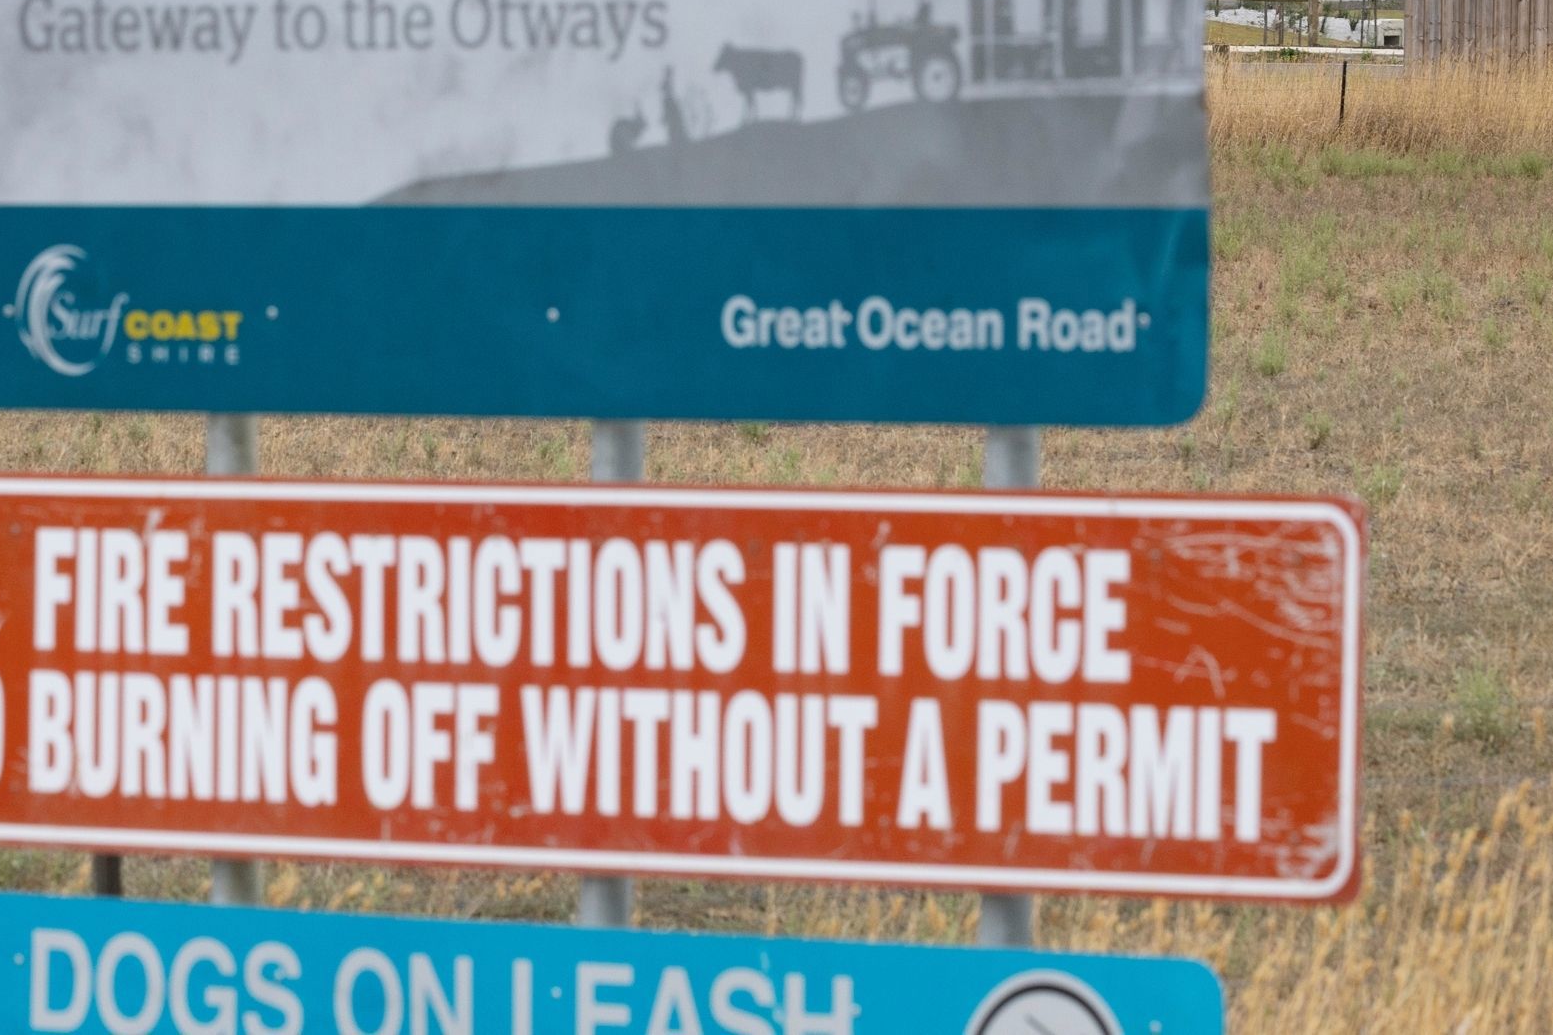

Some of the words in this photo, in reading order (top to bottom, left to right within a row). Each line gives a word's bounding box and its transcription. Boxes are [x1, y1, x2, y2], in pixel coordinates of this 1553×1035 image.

[47, 292, 130, 356] Surf
[123, 309, 244, 341] COAST
[126, 342, 241, 365] SHIRE
[720, 295, 852, 349] Great
[856, 296, 1004, 351] Ocean
[1017, 298, 1137, 353] Road
[34, 525, 189, 656] FIRE
[211, 530, 748, 675] RESTRICTIONS
[772, 541, 851, 676] IN
[878, 544, 1133, 684] FORCE
[26, 667, 339, 809] BURNING
[360, 677, 501, 813] OFF
[520, 683, 879, 828] WITHOUT
[896, 696, 954, 832] A
[975, 698, 1278, 844] PERMIT
[28, 926, 304, 1035] DOGS
[332, 946, 475, 1035] ON
